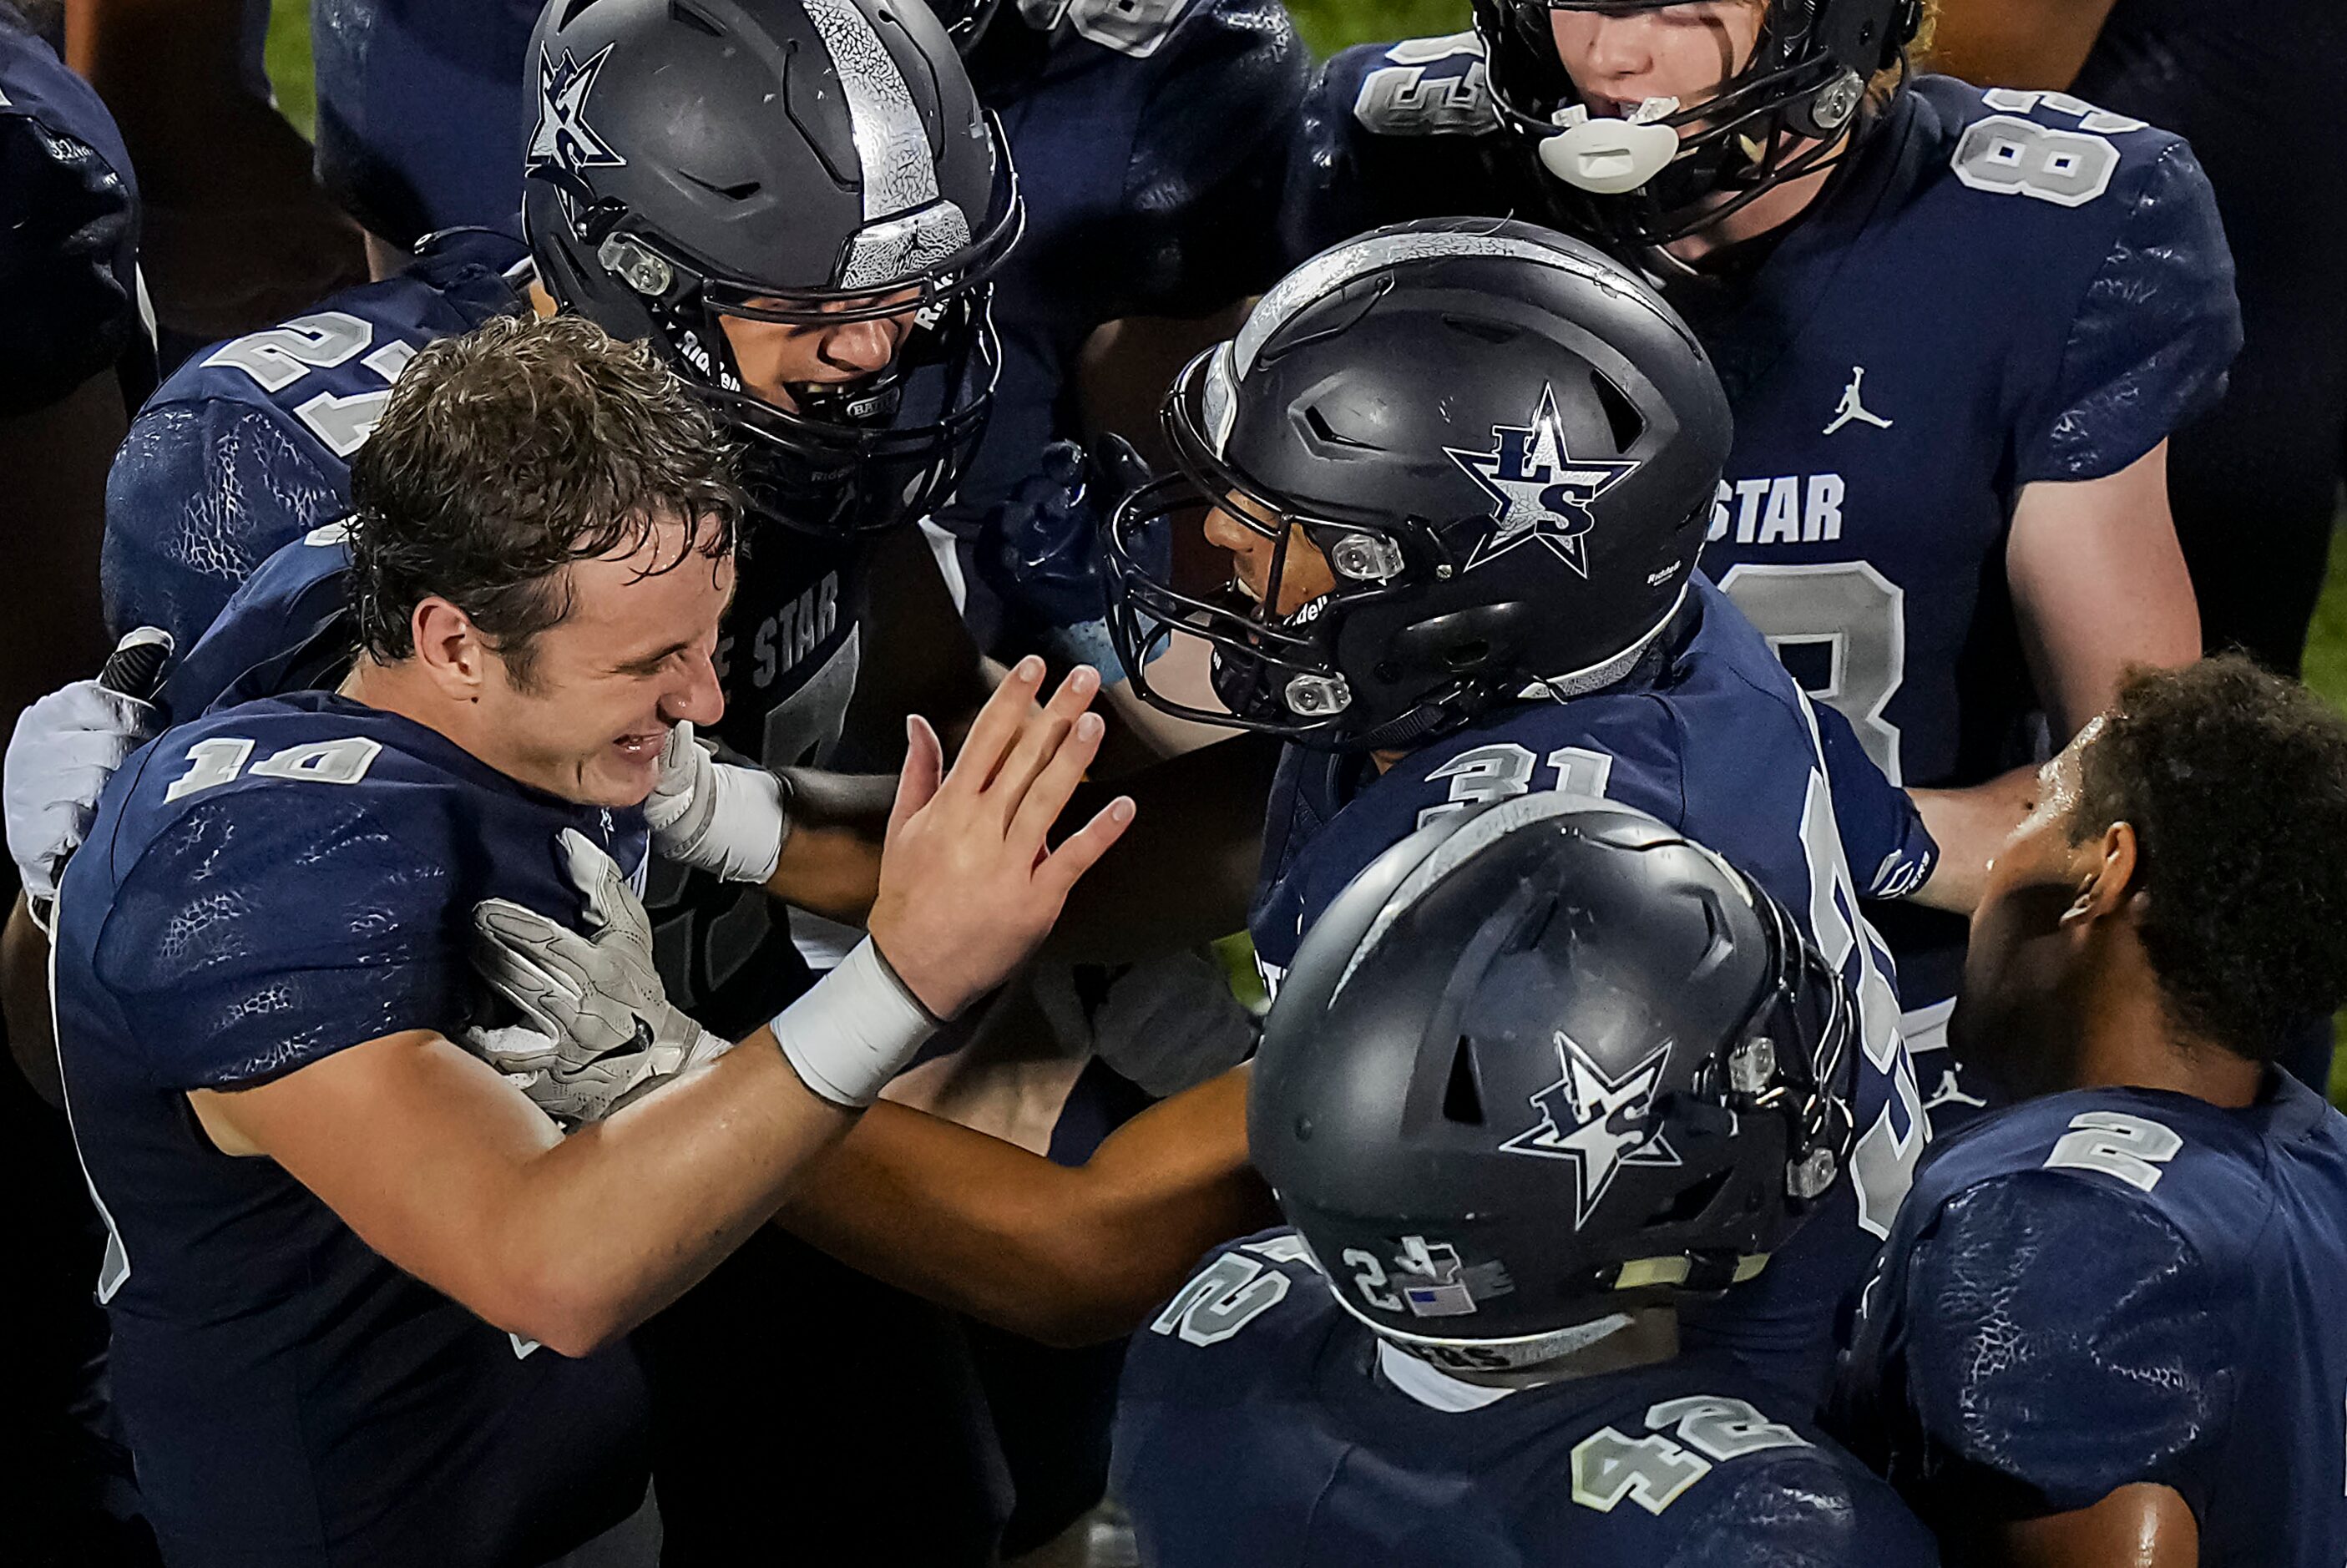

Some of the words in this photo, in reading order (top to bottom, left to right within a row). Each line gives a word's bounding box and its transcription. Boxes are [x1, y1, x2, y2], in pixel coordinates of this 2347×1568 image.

[1490, 425, 1596, 538] LS
[753, 570, 838, 688] STAR
[163, 736, 382, 804] 14
[2042, 1111, 2183, 1192] 2
[1571, 1395, 1817, 1516] 42
